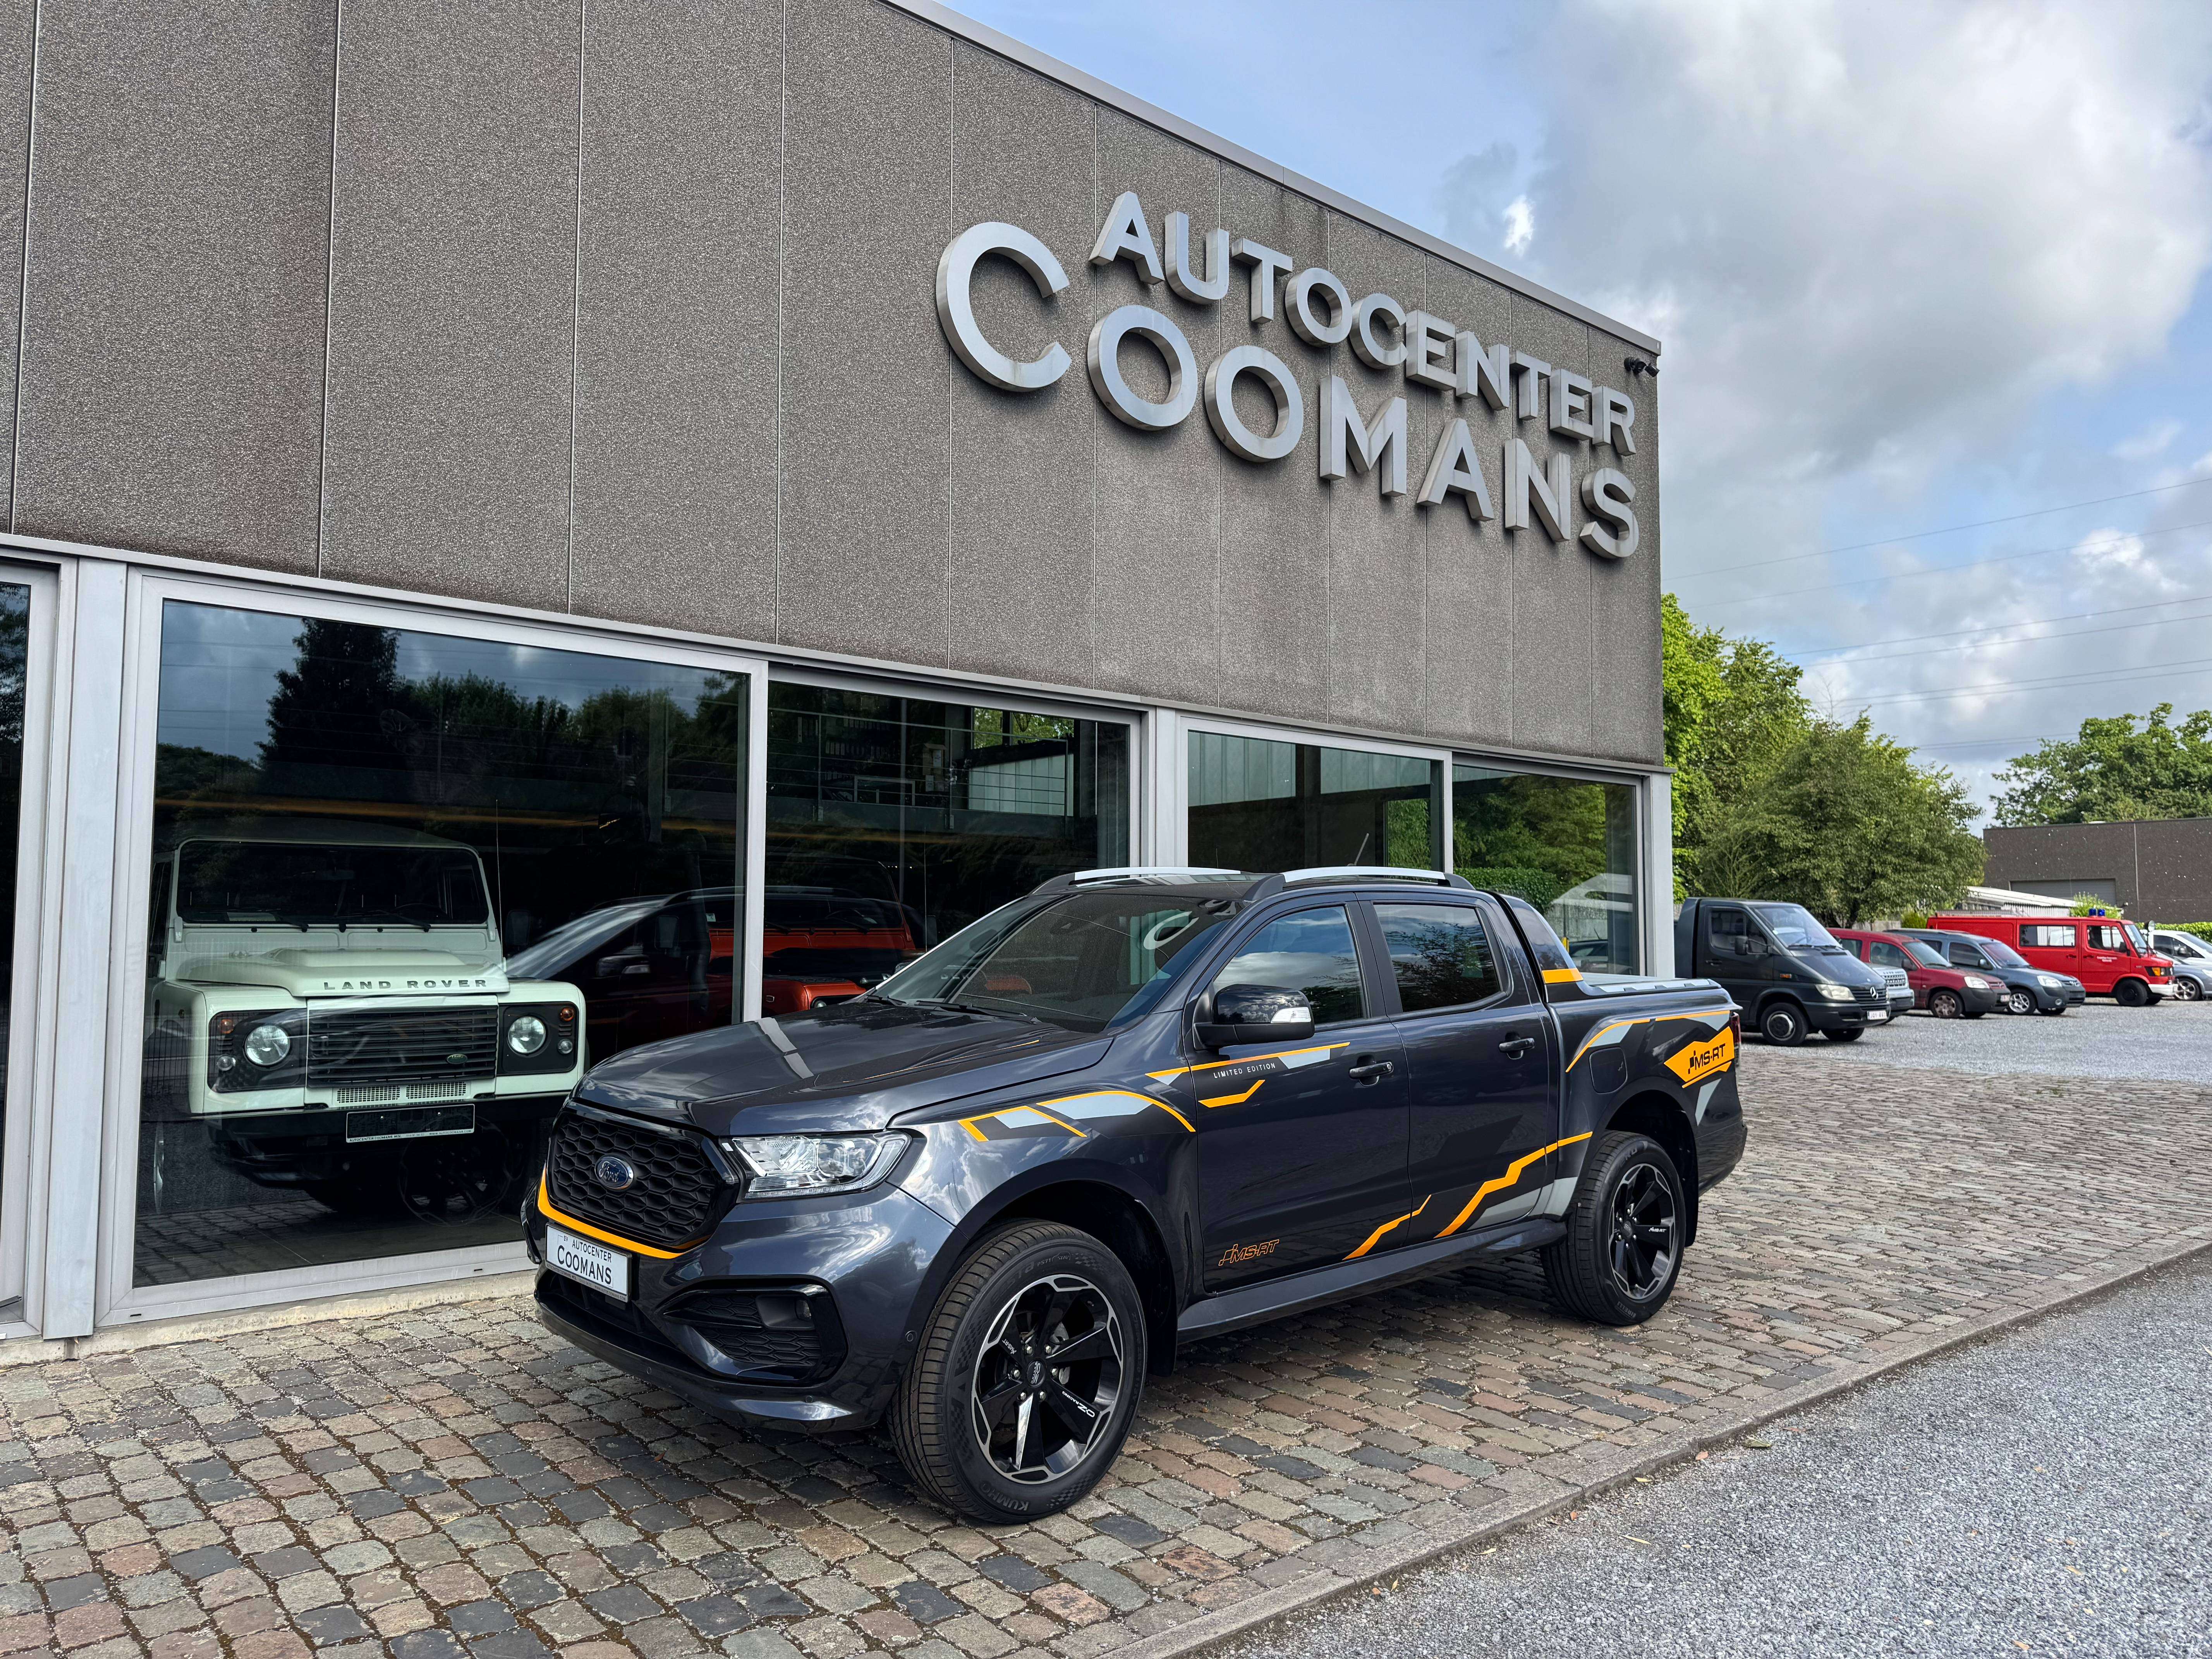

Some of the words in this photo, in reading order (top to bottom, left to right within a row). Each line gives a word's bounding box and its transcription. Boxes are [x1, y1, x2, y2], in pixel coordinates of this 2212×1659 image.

[1088, 191, 1637, 456] AUTOCENTER
[936, 221, 1640, 560] COOMANS
[324, 981, 392, 990] LAND
[407, 979, 487, 989] ROVER
[1213, 1068, 1243, 1079] LIMITED
[1247, 1063, 1276, 1073] EDITION
[599, 1161, 621, 1182] Ford
[572, 1239, 611, 1263] AUTOCENTER
[557, 1245, 611, 1285] COOMANS
[980, 1481, 1029, 1511] KUMHO
